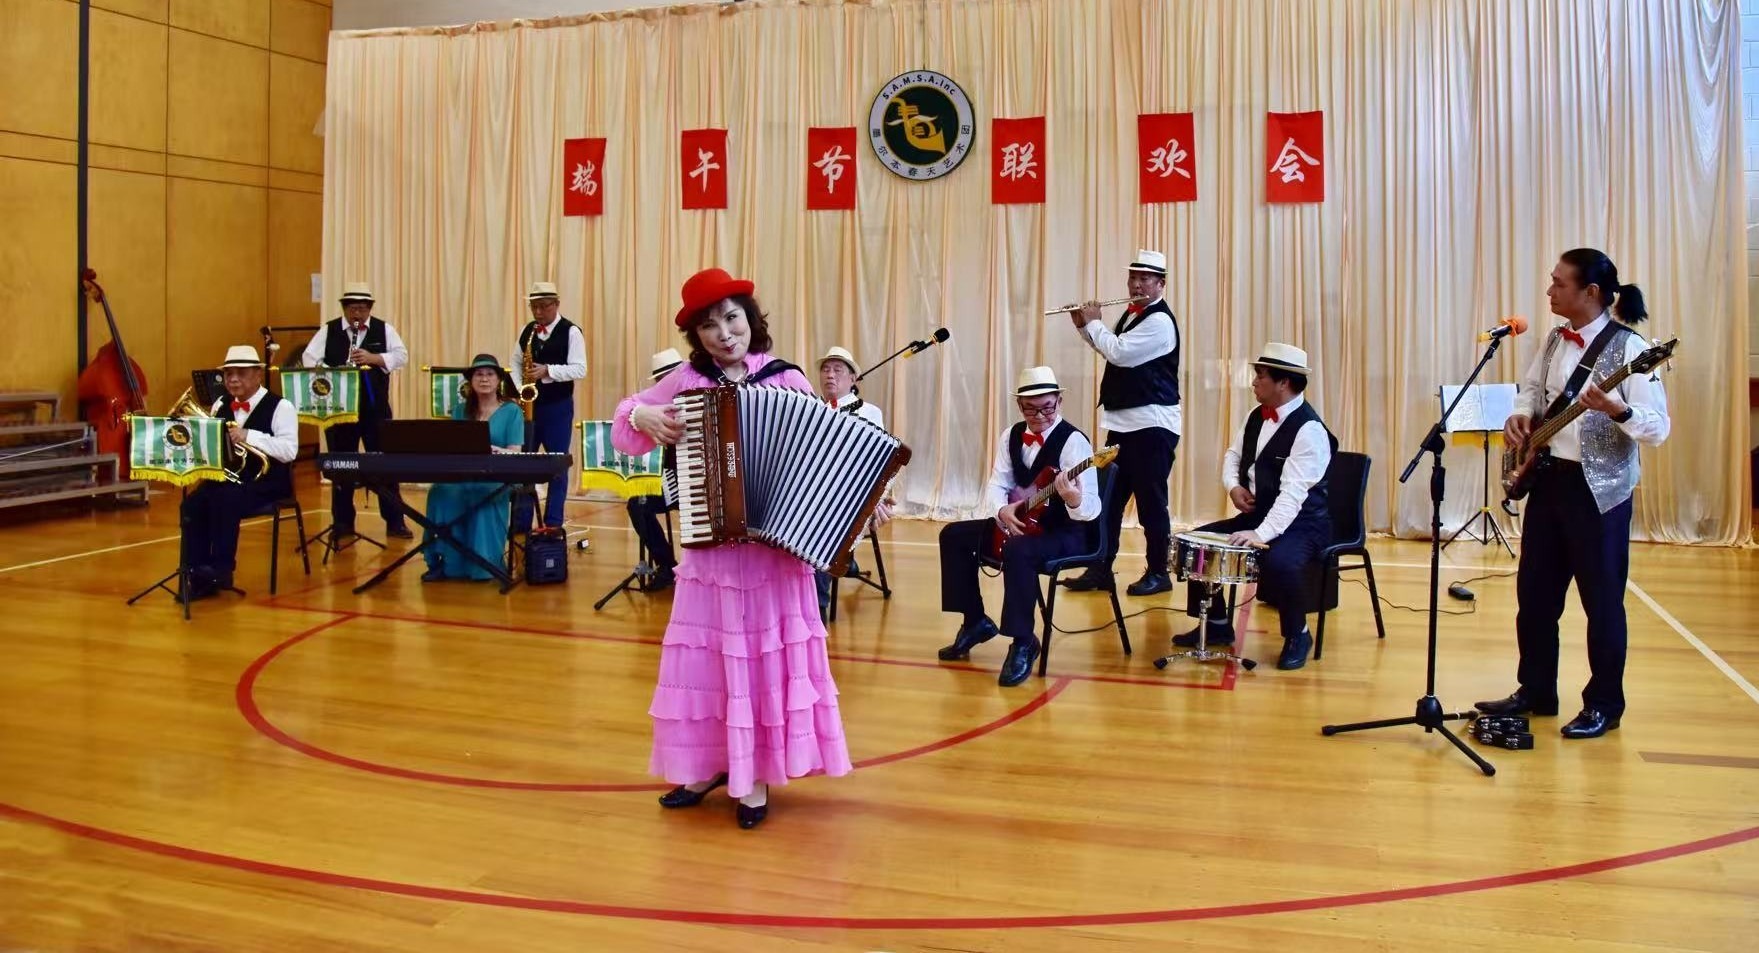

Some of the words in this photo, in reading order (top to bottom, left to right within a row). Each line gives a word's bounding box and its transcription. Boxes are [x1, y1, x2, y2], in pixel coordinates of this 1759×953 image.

[568, 159, 598, 197] 端
[689, 147, 721, 193] 午
[812, 145, 852, 194] 节
[1000, 141, 1037, 182] 联
[1146, 138, 1191, 179] 欢
[1269, 137, 1321, 184] 会
[332, 459, 359, 470] YAMAHA
